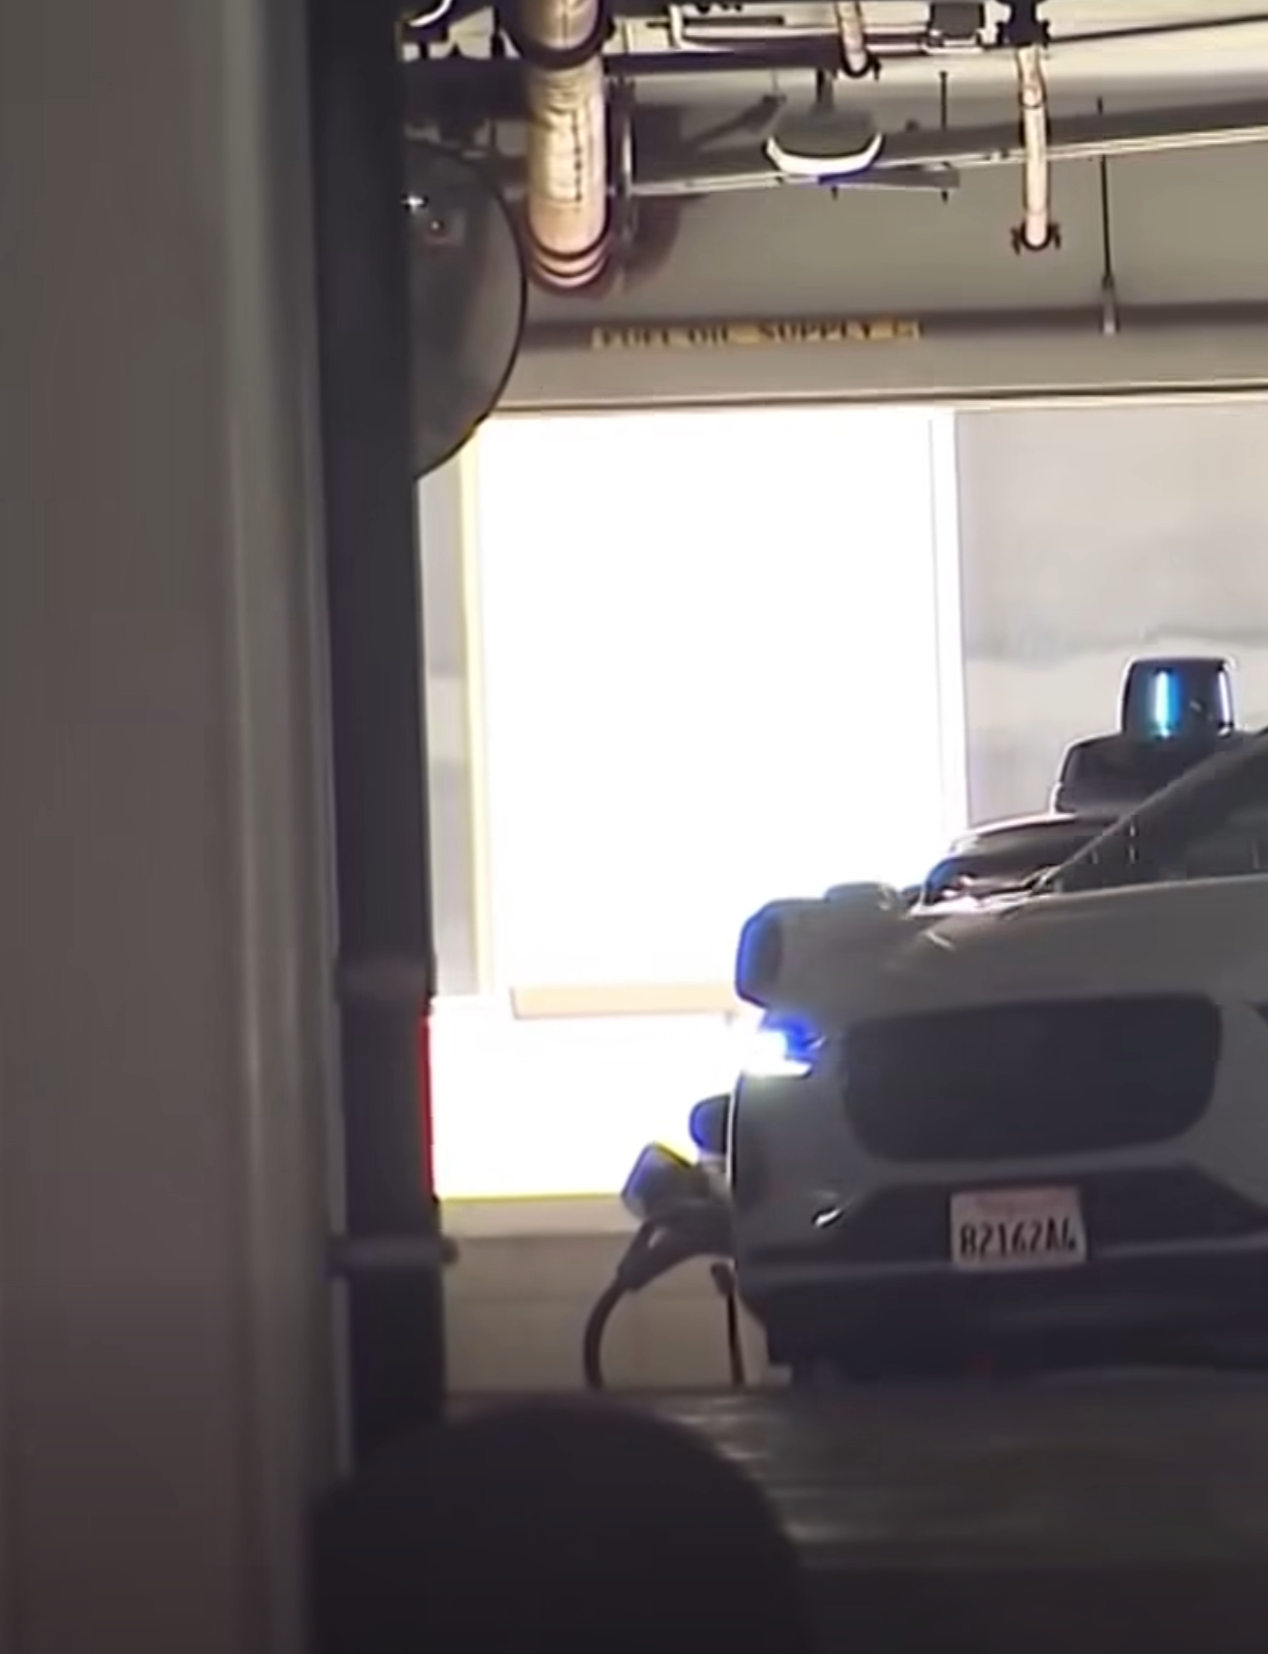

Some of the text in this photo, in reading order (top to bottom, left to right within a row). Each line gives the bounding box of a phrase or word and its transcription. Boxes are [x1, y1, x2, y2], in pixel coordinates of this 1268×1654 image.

[600, 320, 873, 347] FUEL OIL SUPPLY
